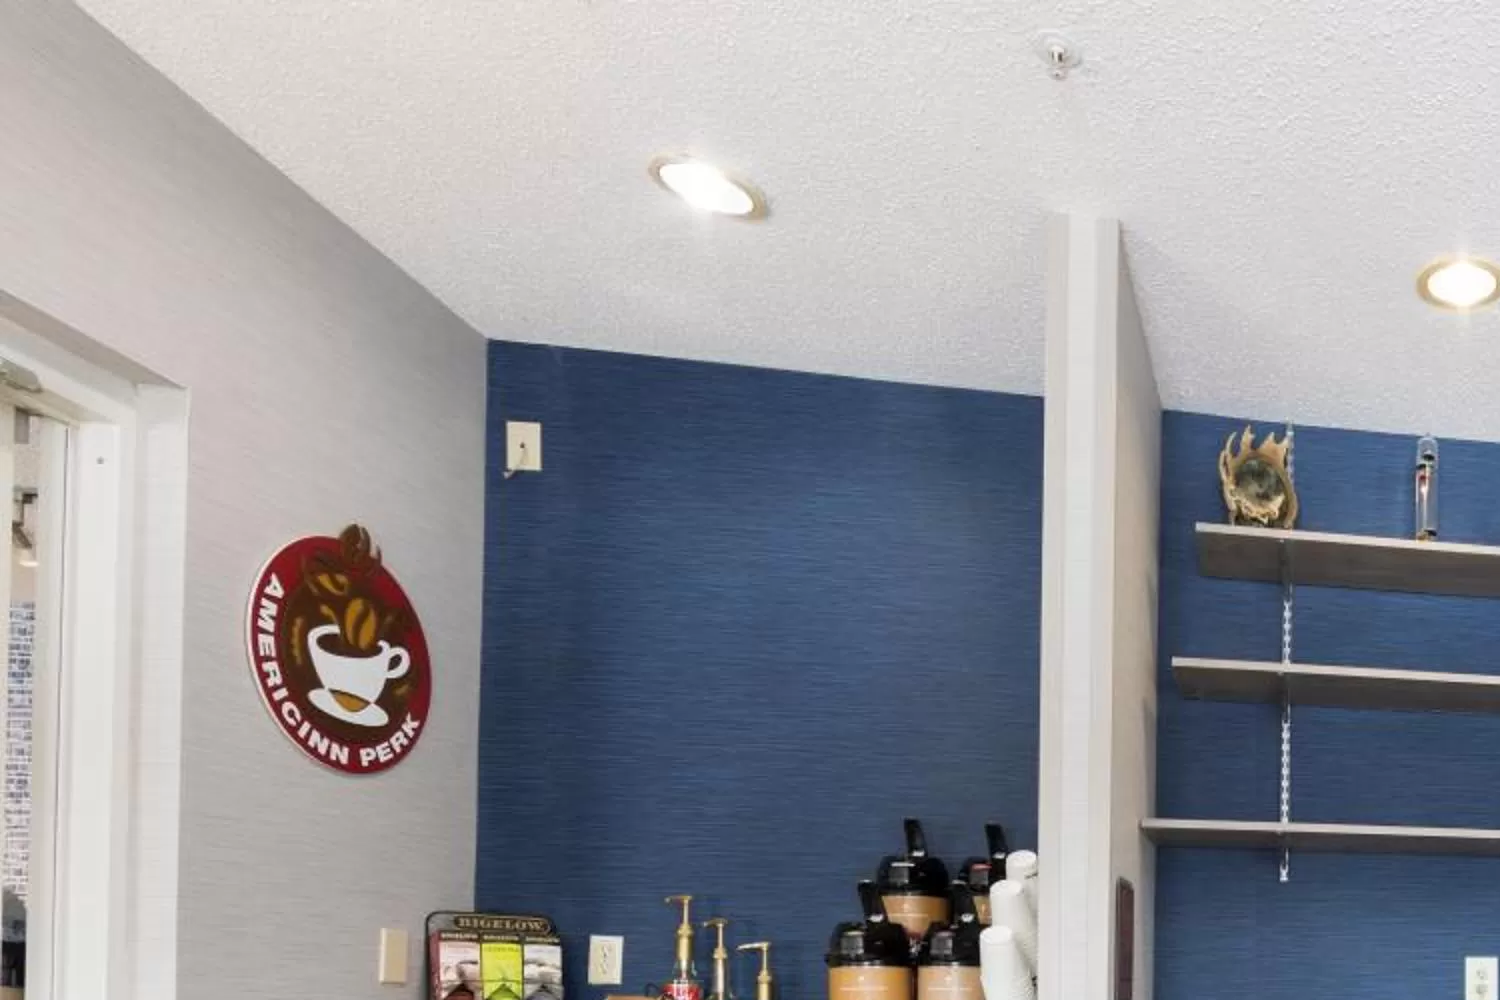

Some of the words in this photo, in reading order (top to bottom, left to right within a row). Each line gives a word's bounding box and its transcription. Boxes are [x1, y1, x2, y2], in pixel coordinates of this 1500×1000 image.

[257, 572, 349, 765] AMERICINN
[360, 712, 421, 767] PERK
[458, 916, 546, 931] BIGELOW
